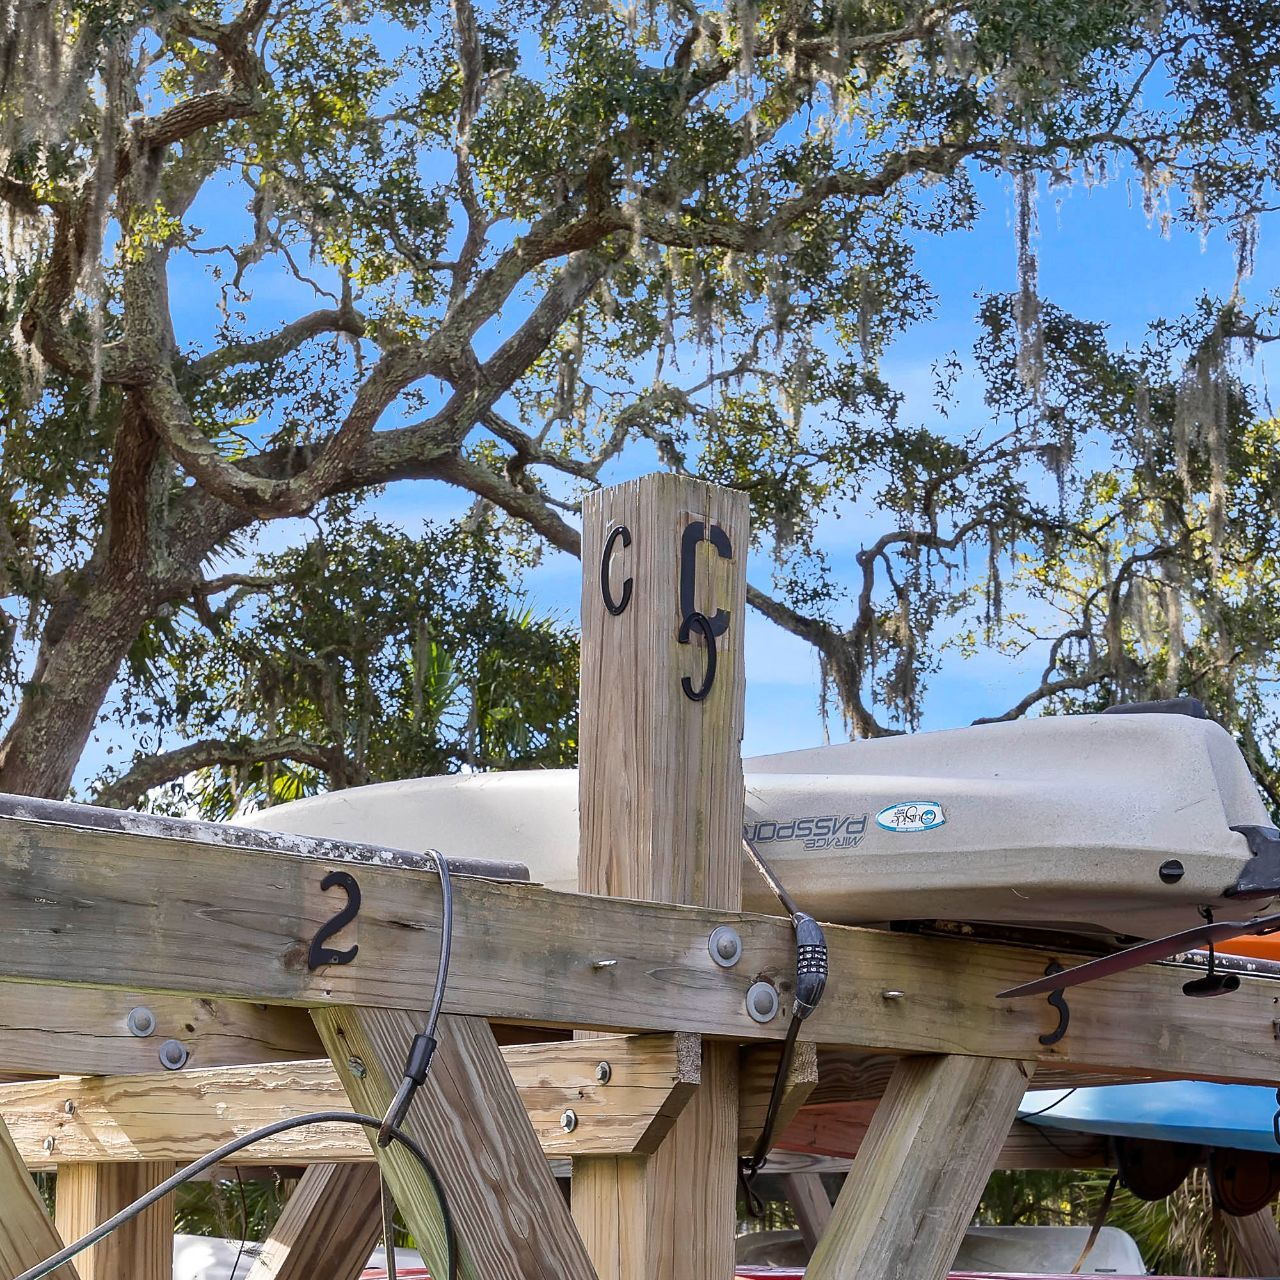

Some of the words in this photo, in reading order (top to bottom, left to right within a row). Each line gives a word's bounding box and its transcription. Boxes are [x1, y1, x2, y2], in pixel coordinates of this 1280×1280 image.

[601, 525, 634, 616] C
[680, 521, 733, 638] C
[805, 836, 864, 849] MIRAGE
[307, 870, 361, 971] 2
[1039, 961, 1070, 1046] 3
